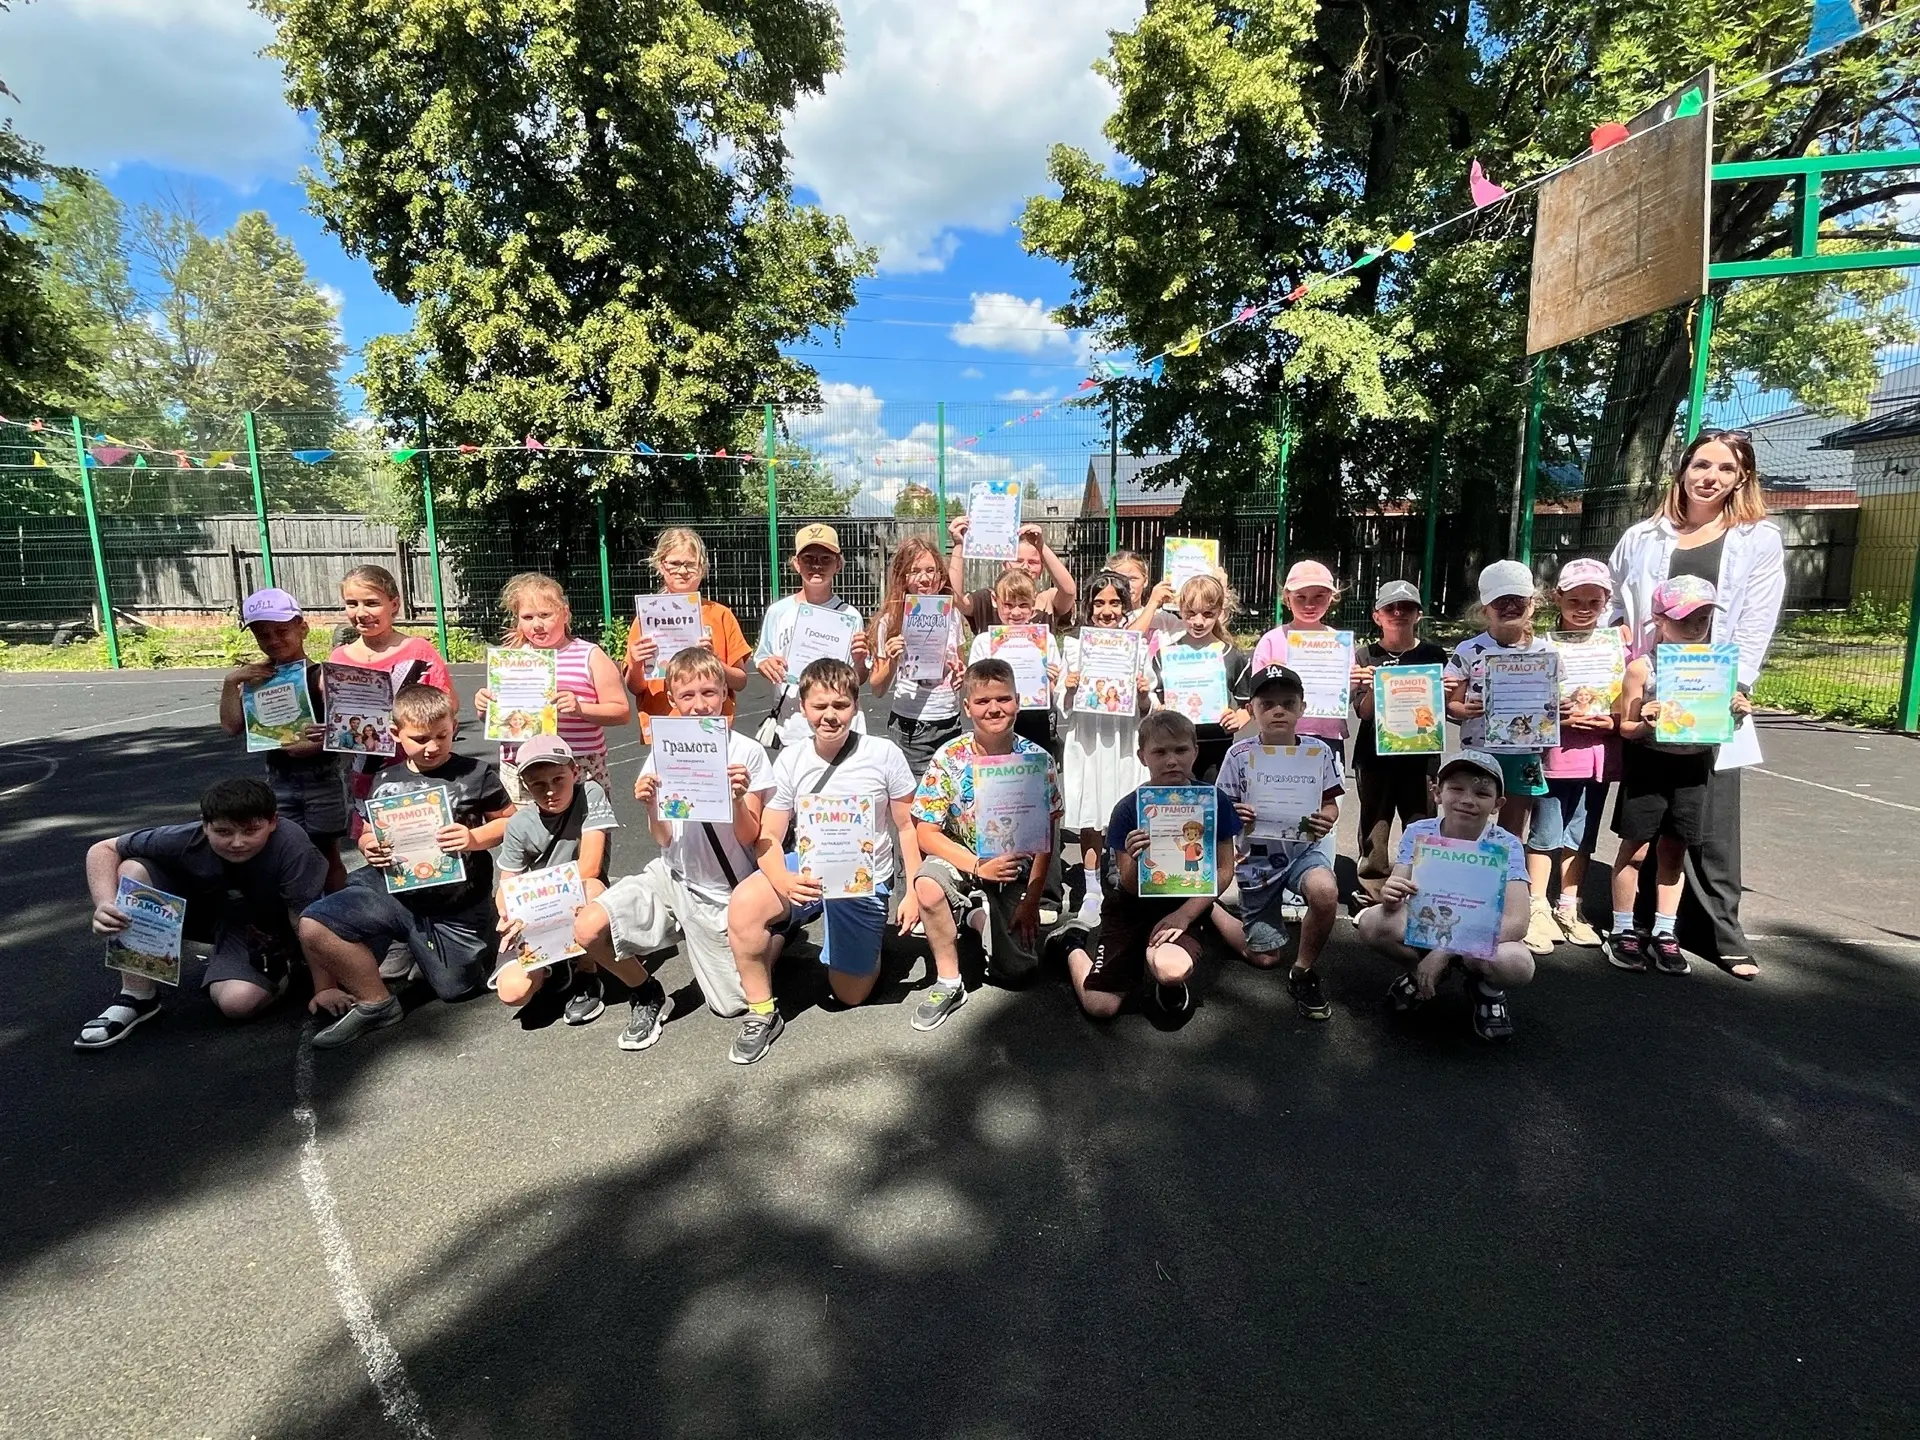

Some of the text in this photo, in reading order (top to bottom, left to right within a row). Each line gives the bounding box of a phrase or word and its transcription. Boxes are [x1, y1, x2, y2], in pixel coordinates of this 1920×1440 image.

[647, 616, 694, 628] Грамота
[907, 614, 947, 628] ГРАМОТА
[805, 627, 840, 643] Грамота
[1297, 641, 1340, 649] ГРАМОТА
[1167, 652, 1217, 661] ГРАМОТА
[1663, 654, 1730, 665] ГРАМОТА
[500, 659, 545, 668] ГРАМОТА
[1496, 663, 1546, 673] ГРАМОТА
[1266, 665, 1282, 679] LA
[1390, 678, 1427, 687] ГРАМОТА
[257, 686, 291, 699] ГРАМОТА
[662, 739, 718, 756] Грамота
[979, 764, 1041, 777] ГРАМОТА
[1257, 772, 1316, 785] Грамота
[386, 806, 435, 822] ГРАМОТА
[1161, 806, 1195, 814] ГРАМОТА
[809, 812, 861, 824] ГРАМОТА
[1421, 847, 1499, 867] ГРАМОТА
[516, 883, 570, 906] ГРАМОТА
[126, 896, 174, 920] ГРАМОТА
